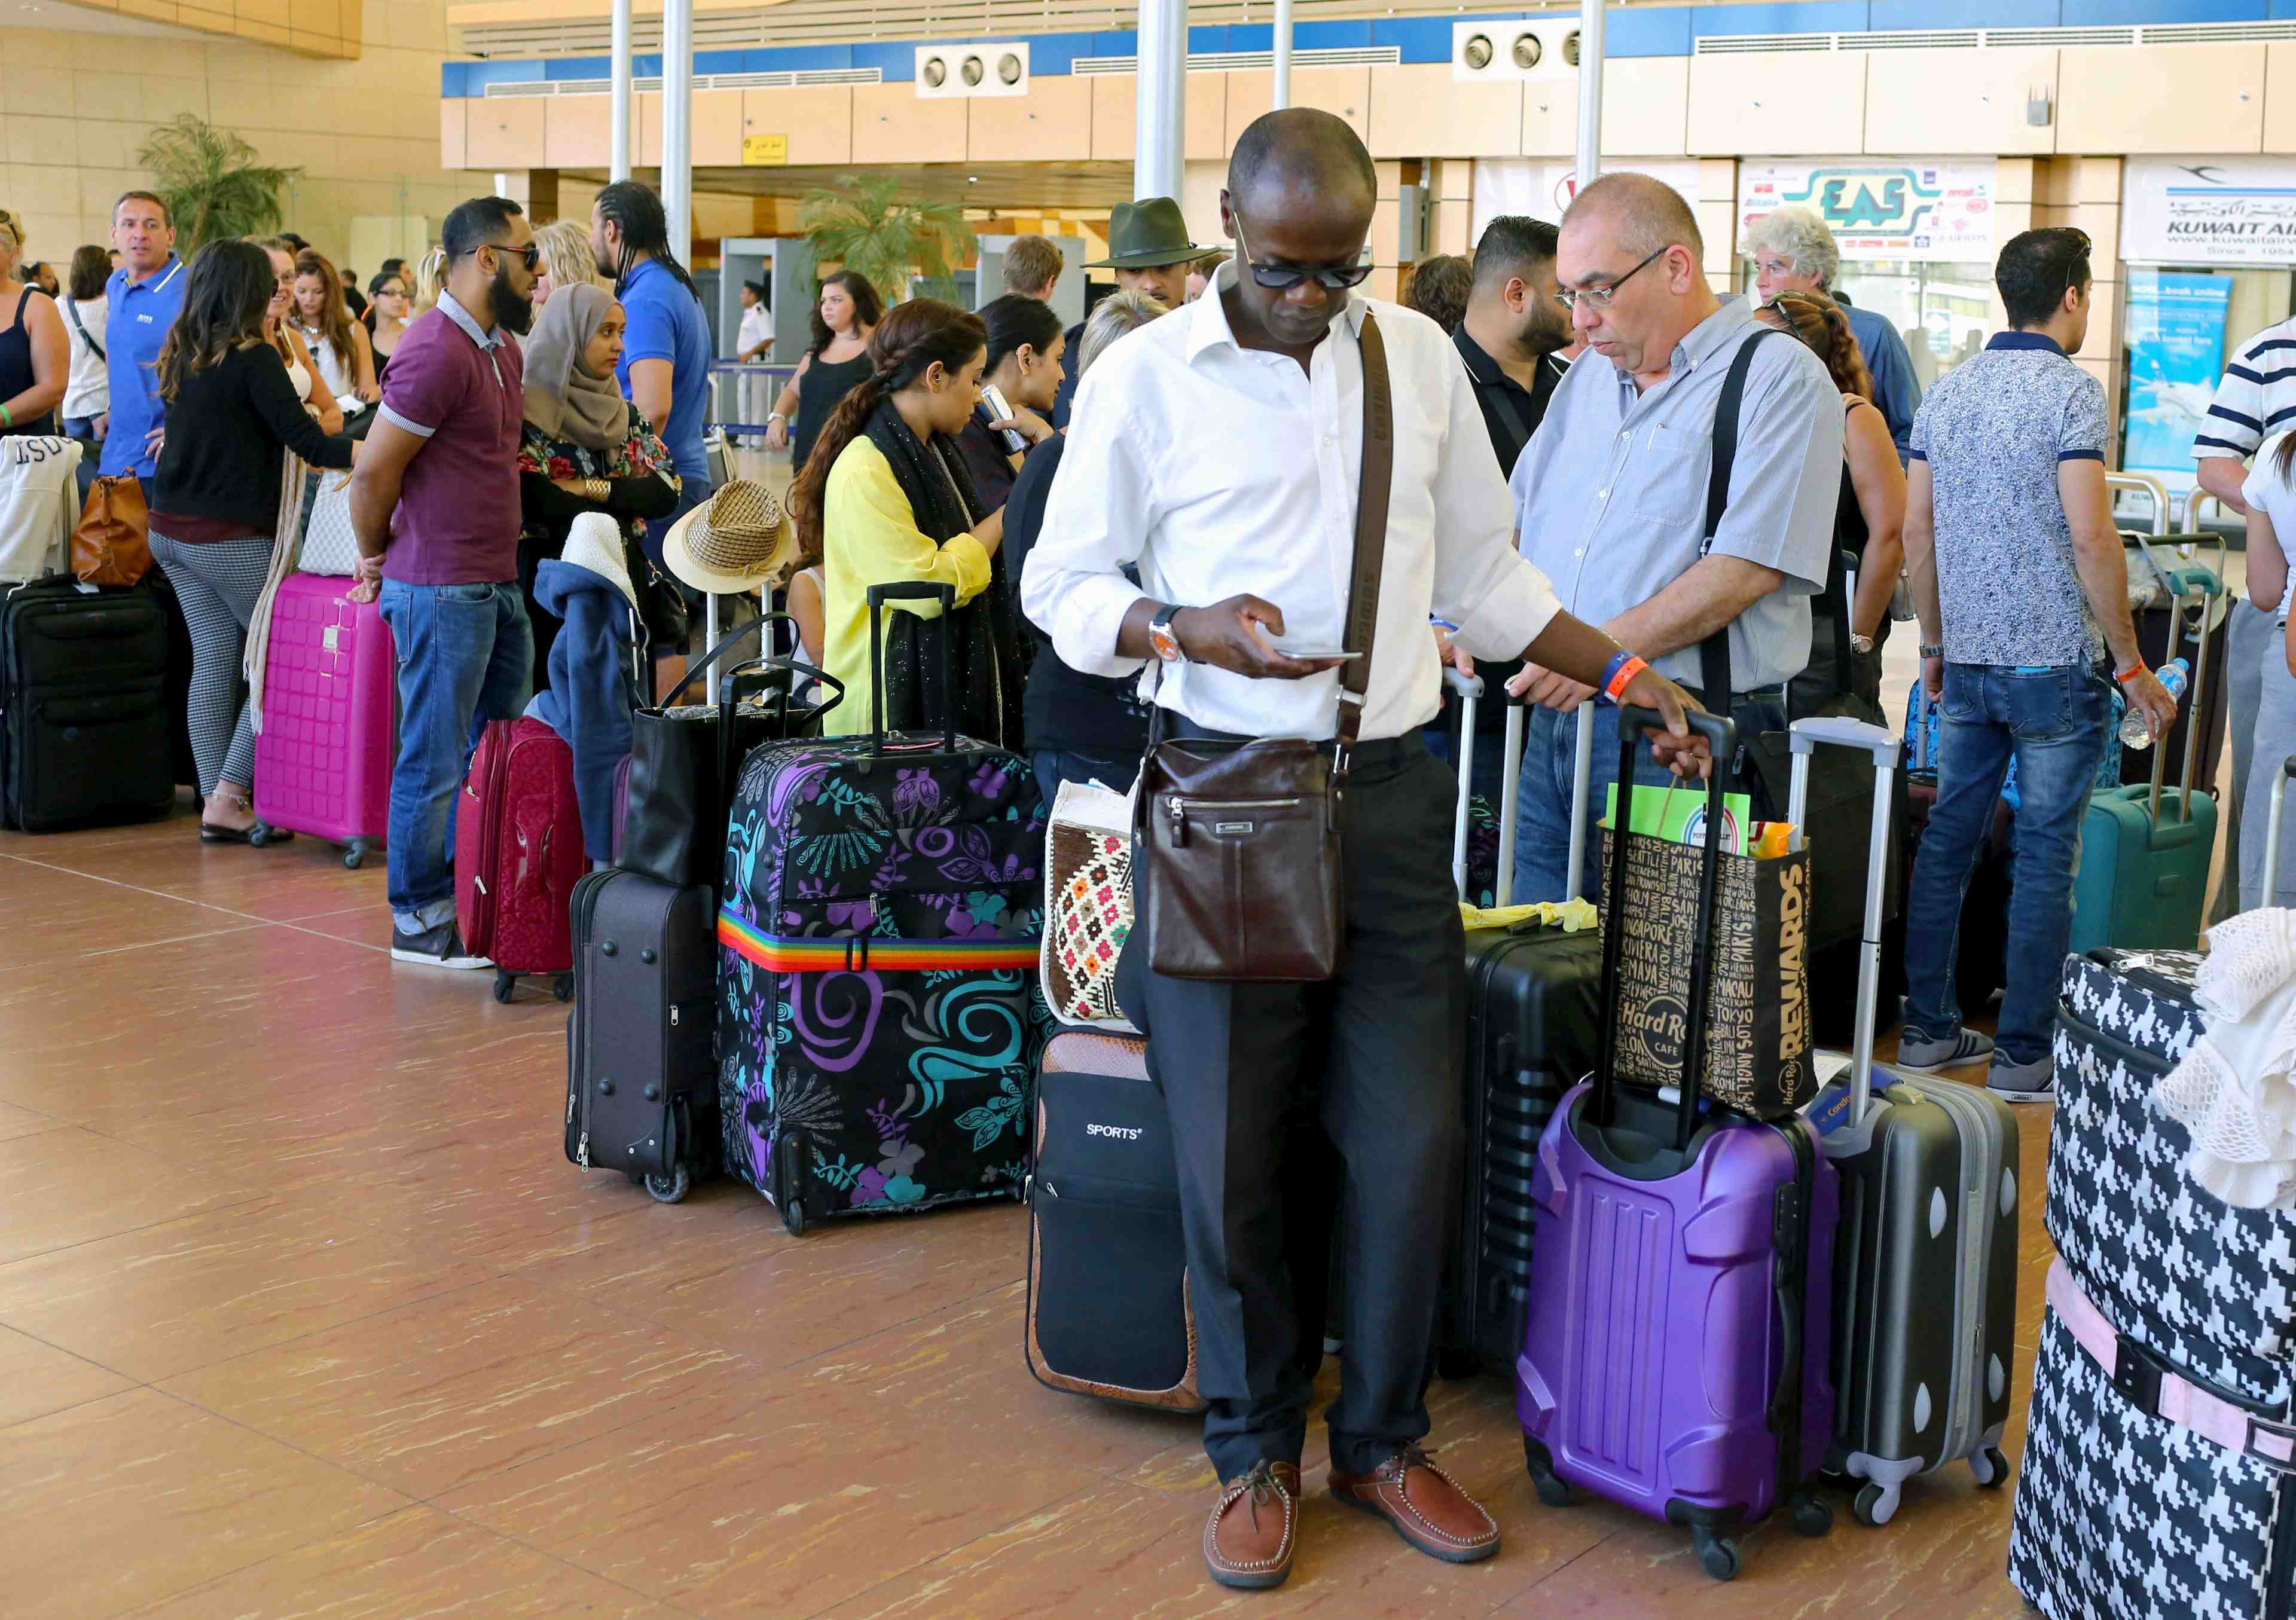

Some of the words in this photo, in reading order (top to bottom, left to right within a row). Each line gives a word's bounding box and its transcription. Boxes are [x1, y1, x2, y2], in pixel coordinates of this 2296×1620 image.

[1821, 179, 1905, 226] EAS
[2167, 222, 2266, 234] KUWAIT
[1660, 896, 1672, 924] BALI
[1731, 921, 1754, 962] PARIS
[1628, 959, 1657, 985] MAYA
[1779, 864, 1803, 1060] REWARDS
[1715, 977, 1754, 999] MACAU
[1622, 1002, 1667, 1033] Hard
[1714, 1004, 1754, 1025] TOKYO
[1736, 1024, 1754, 1050] LOS
[1785, 1052, 1796, 1076] Rock
[1782, 1078, 1794, 1105] Hard
[1827, 1095, 1851, 1117] Condo
